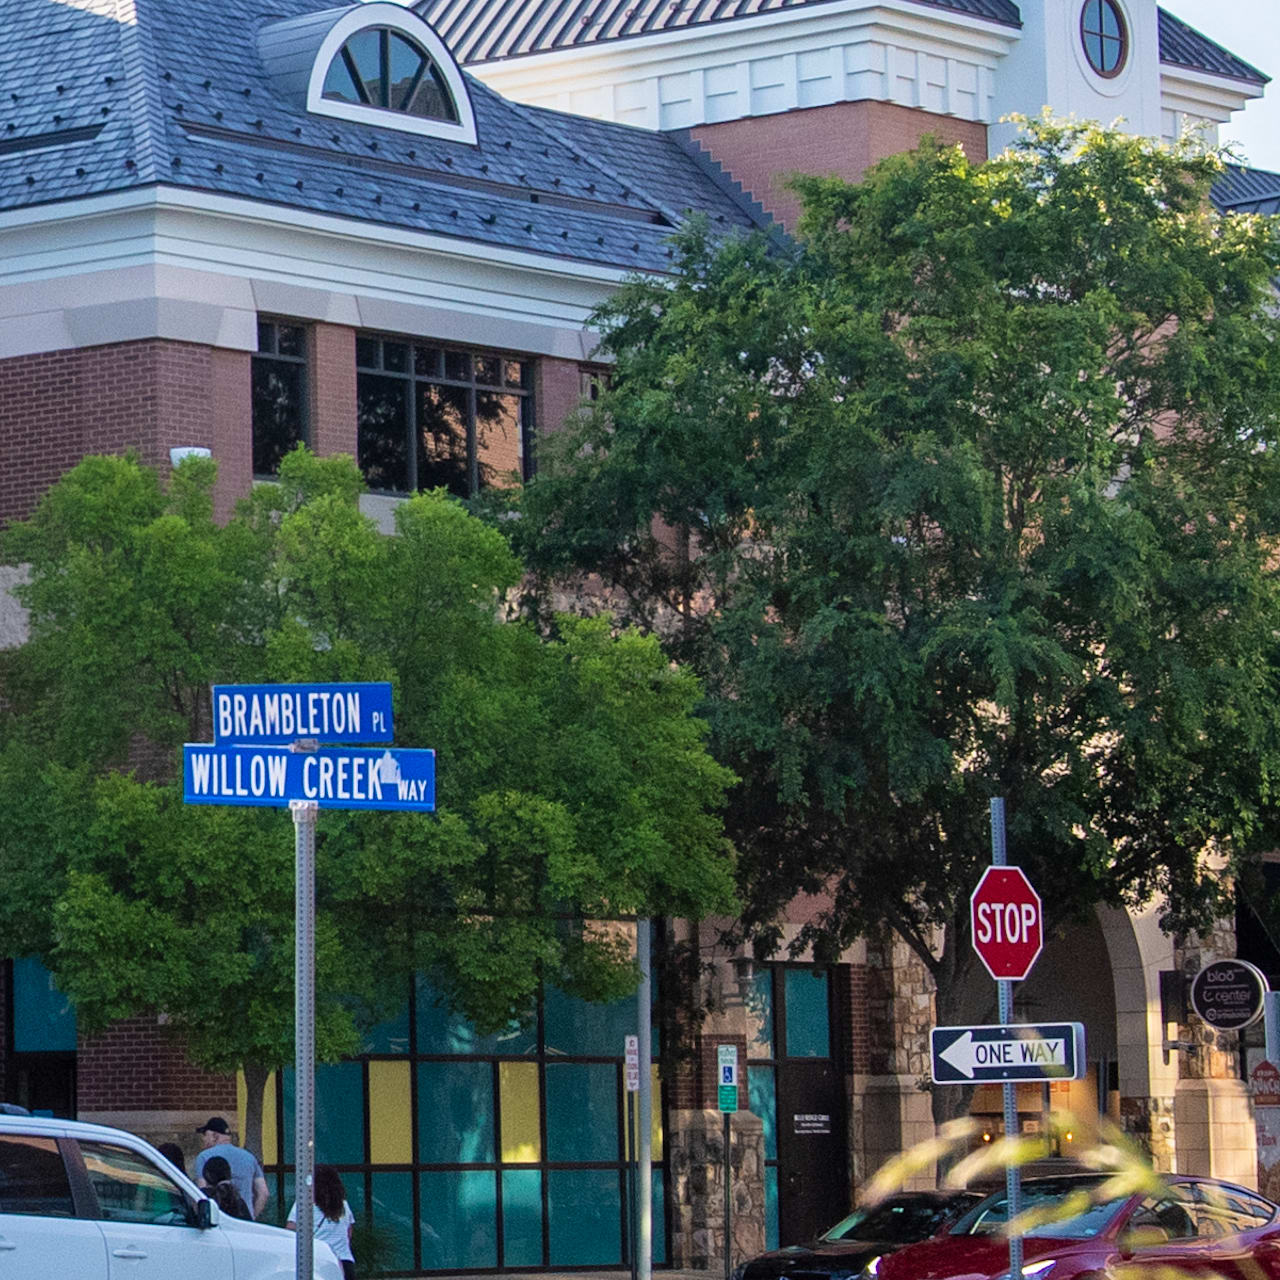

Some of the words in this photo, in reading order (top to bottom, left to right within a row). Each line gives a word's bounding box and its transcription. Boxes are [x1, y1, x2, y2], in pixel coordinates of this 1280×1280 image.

[218, 692, 361, 737] BRAMBLETON
[372, 710, 387, 733] PL
[191, 754, 287, 797] WILLOW
[303, 756, 383, 800] CREEK
[397, 779, 427, 801] WAY
[977, 902, 1037, 944] STOP
[976, 1043, 1014, 1065] ONE
[1020, 1041, 1059, 1063] WAY
